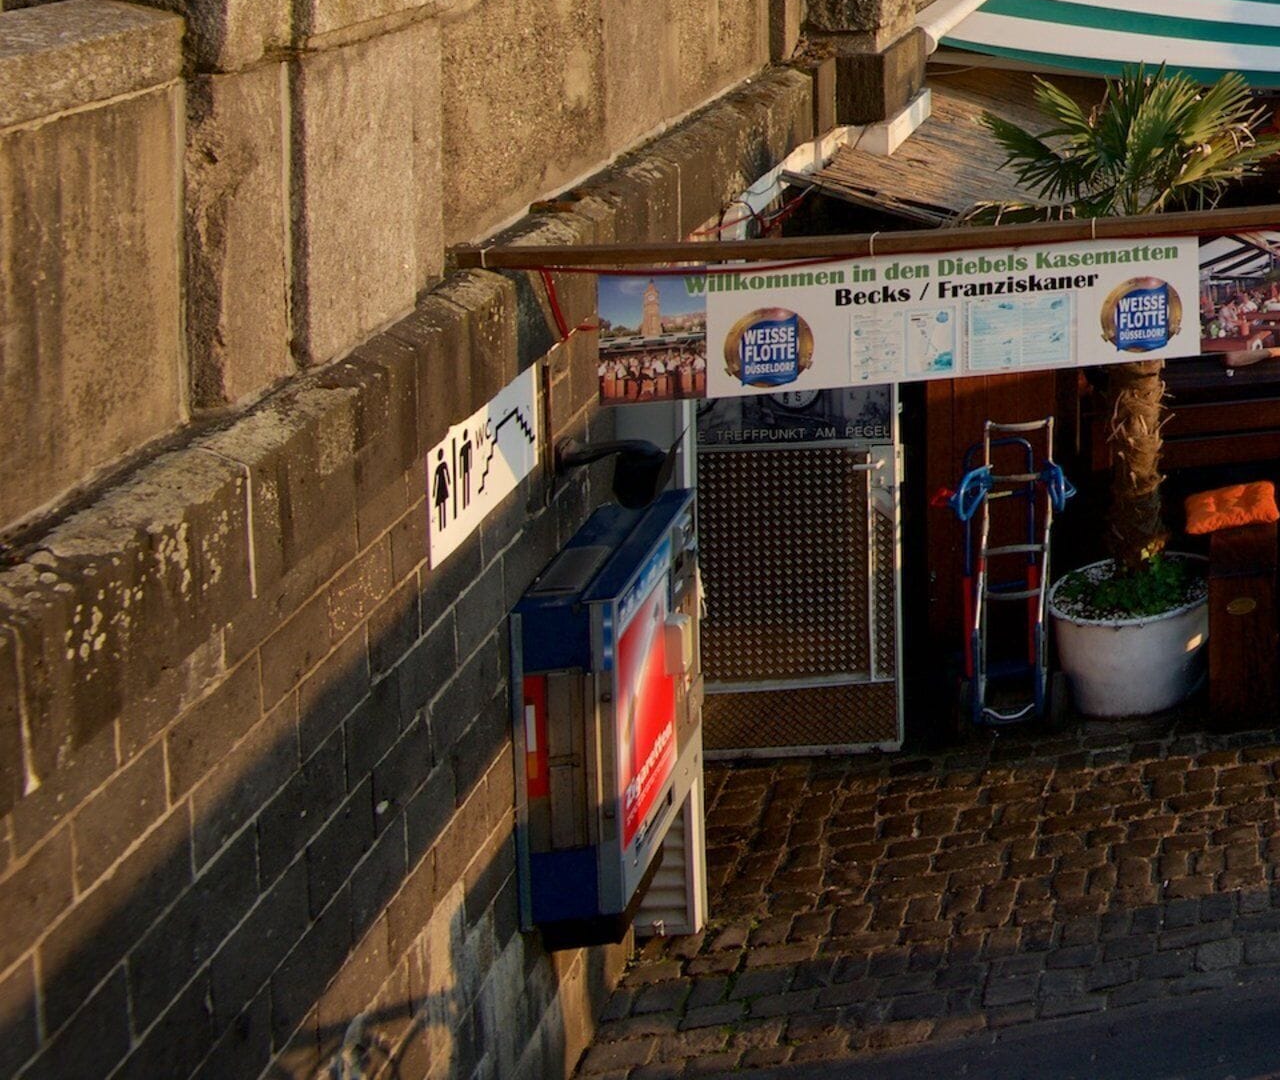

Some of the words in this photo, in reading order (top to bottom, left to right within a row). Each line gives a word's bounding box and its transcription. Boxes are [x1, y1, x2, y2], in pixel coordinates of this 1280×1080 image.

[684, 268, 845, 295] Willkommen
[852, 264, 876, 283] in
[884, 261, 930, 281] den
[937, 253, 1028, 278] Diebels
[1035, 245, 1179, 270] Kasematten
[835, 285, 911, 307] Becks
[918, 281, 930, 301] /
[938, 273, 1099, 299] Franziskaner
[1118, 294, 1166, 312] WEISSE
[1119, 309, 1166, 329] FLOTTE
[743, 326, 795, 345] WEISSE
[1119, 327, 1166, 341] DÜSSELDORF
[744, 341, 795, 362] FLOTTE
[744, 361, 795, 376] DÜSSELDORF
[475, 418, 492, 451] WC
[716, 427, 806, 441] TREFFPUNKT
[814, 426, 836, 439] AM
[845, 424, 890, 438] PEGEL
[625, 719, 673, 812] Zigaretten
